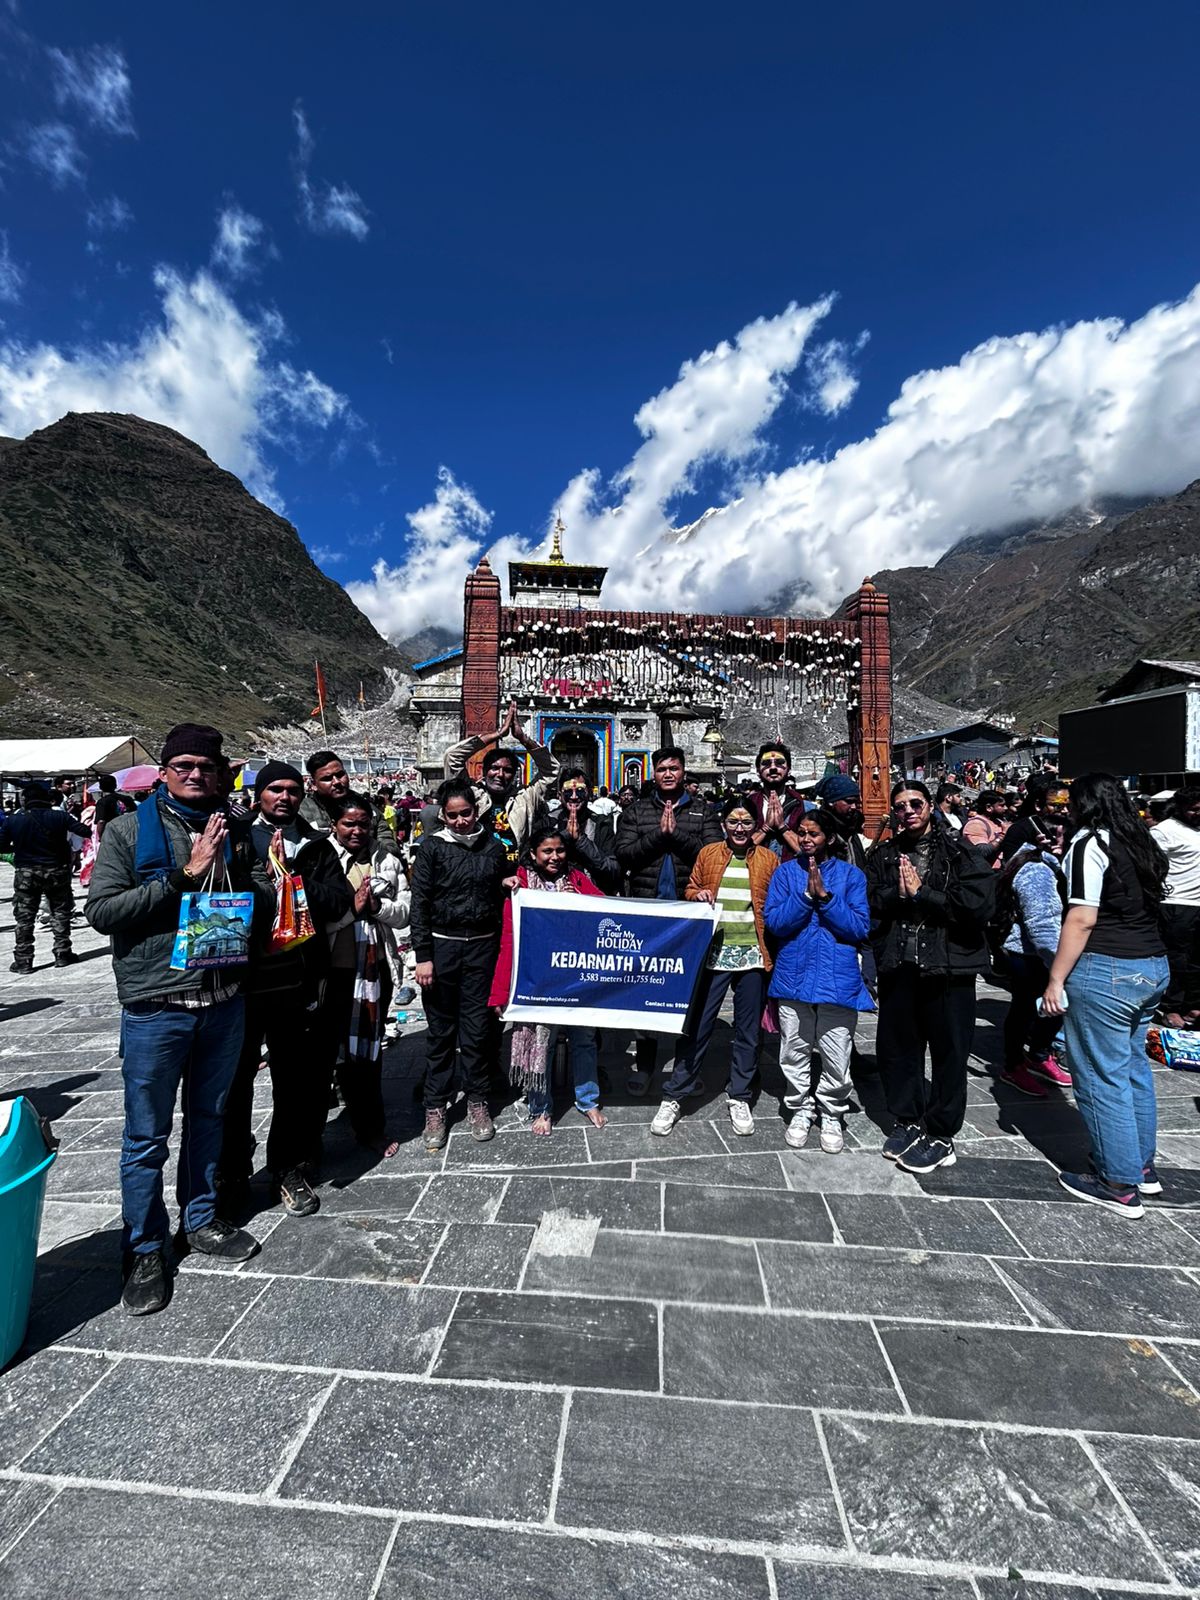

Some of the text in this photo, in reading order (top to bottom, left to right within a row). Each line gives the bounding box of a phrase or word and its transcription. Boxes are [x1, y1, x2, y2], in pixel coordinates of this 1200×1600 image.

[606, 929, 635, 941] Tour My
[596, 937, 644, 950] HOLIDAY
[551, 951, 685, 975] KEDARNATH YATRA
[579, 973, 665, 985] 3,583 meters (11,755 feet)
[645, 1000, 666, 1008] Contact
